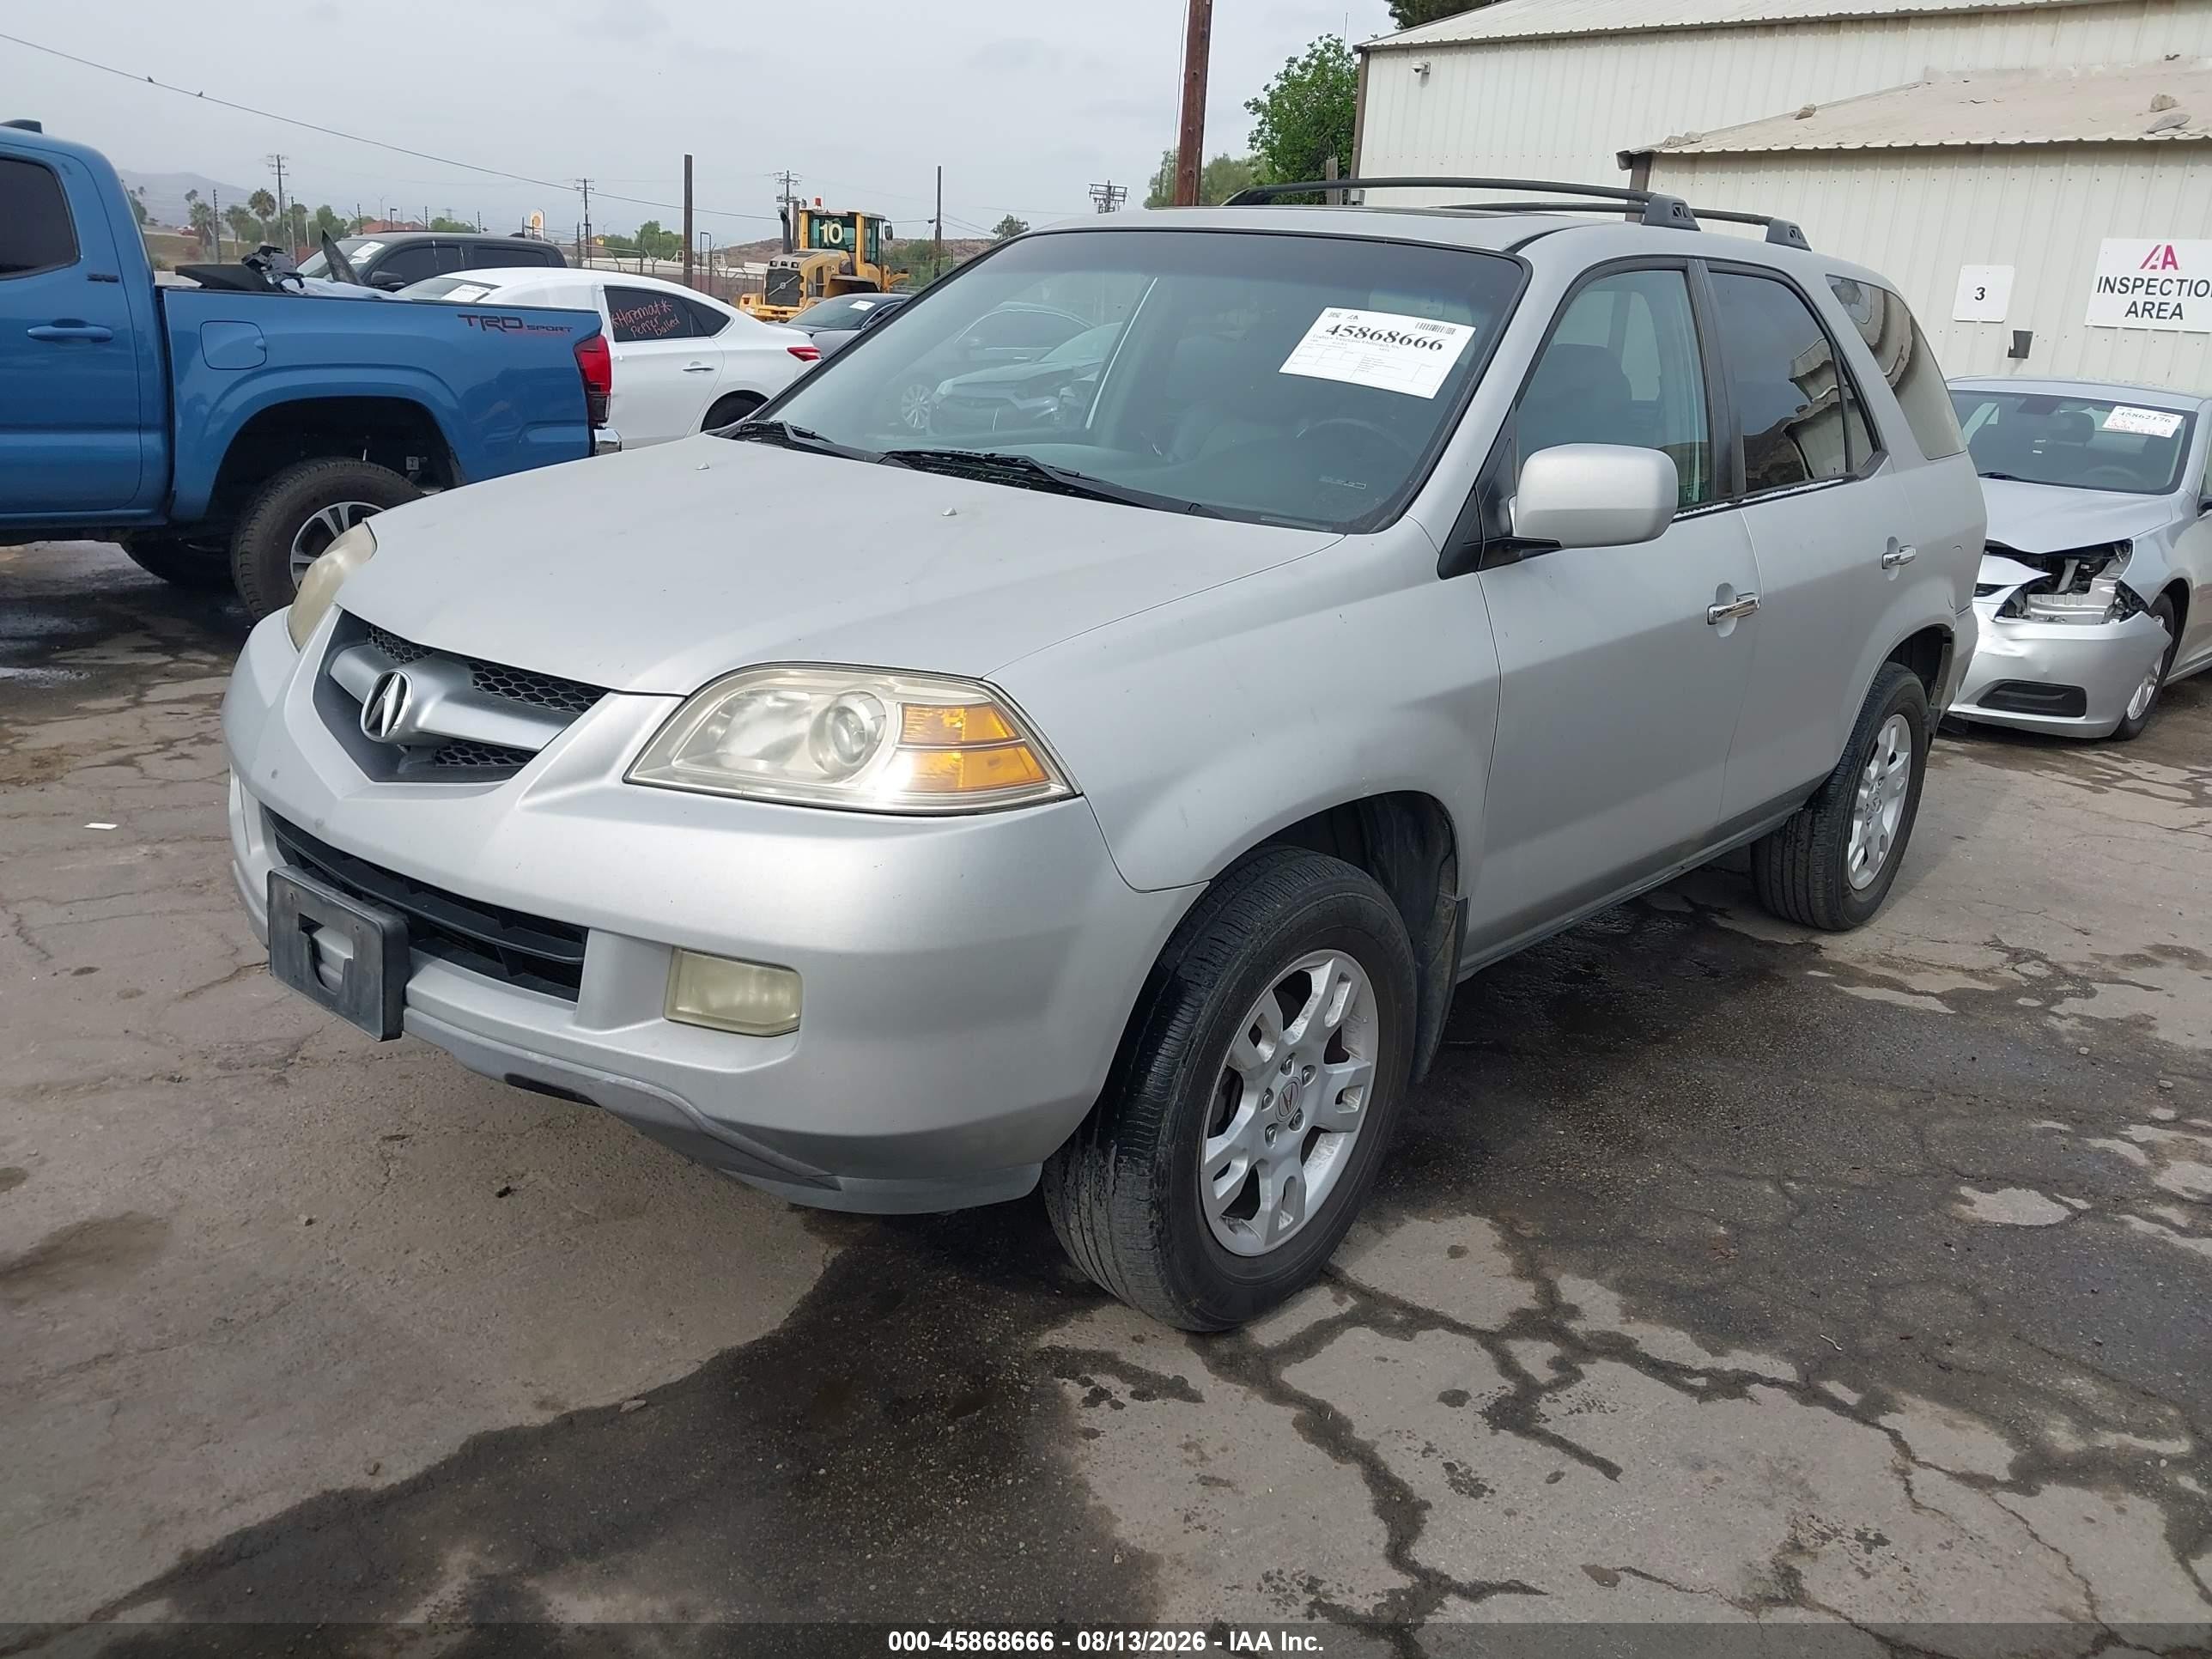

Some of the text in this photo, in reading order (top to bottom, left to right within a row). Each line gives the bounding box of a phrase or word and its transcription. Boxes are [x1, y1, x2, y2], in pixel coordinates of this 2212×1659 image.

[819, 223, 843, 244] 10
[1974, 287, 1986, 301] 3
[2096, 276, 2212, 298] INSPECTIO
[2124, 301, 2184, 320] AREA
[457, 313, 574, 332] TRD SPORT
[1325, 323, 1448, 352] 45868666
